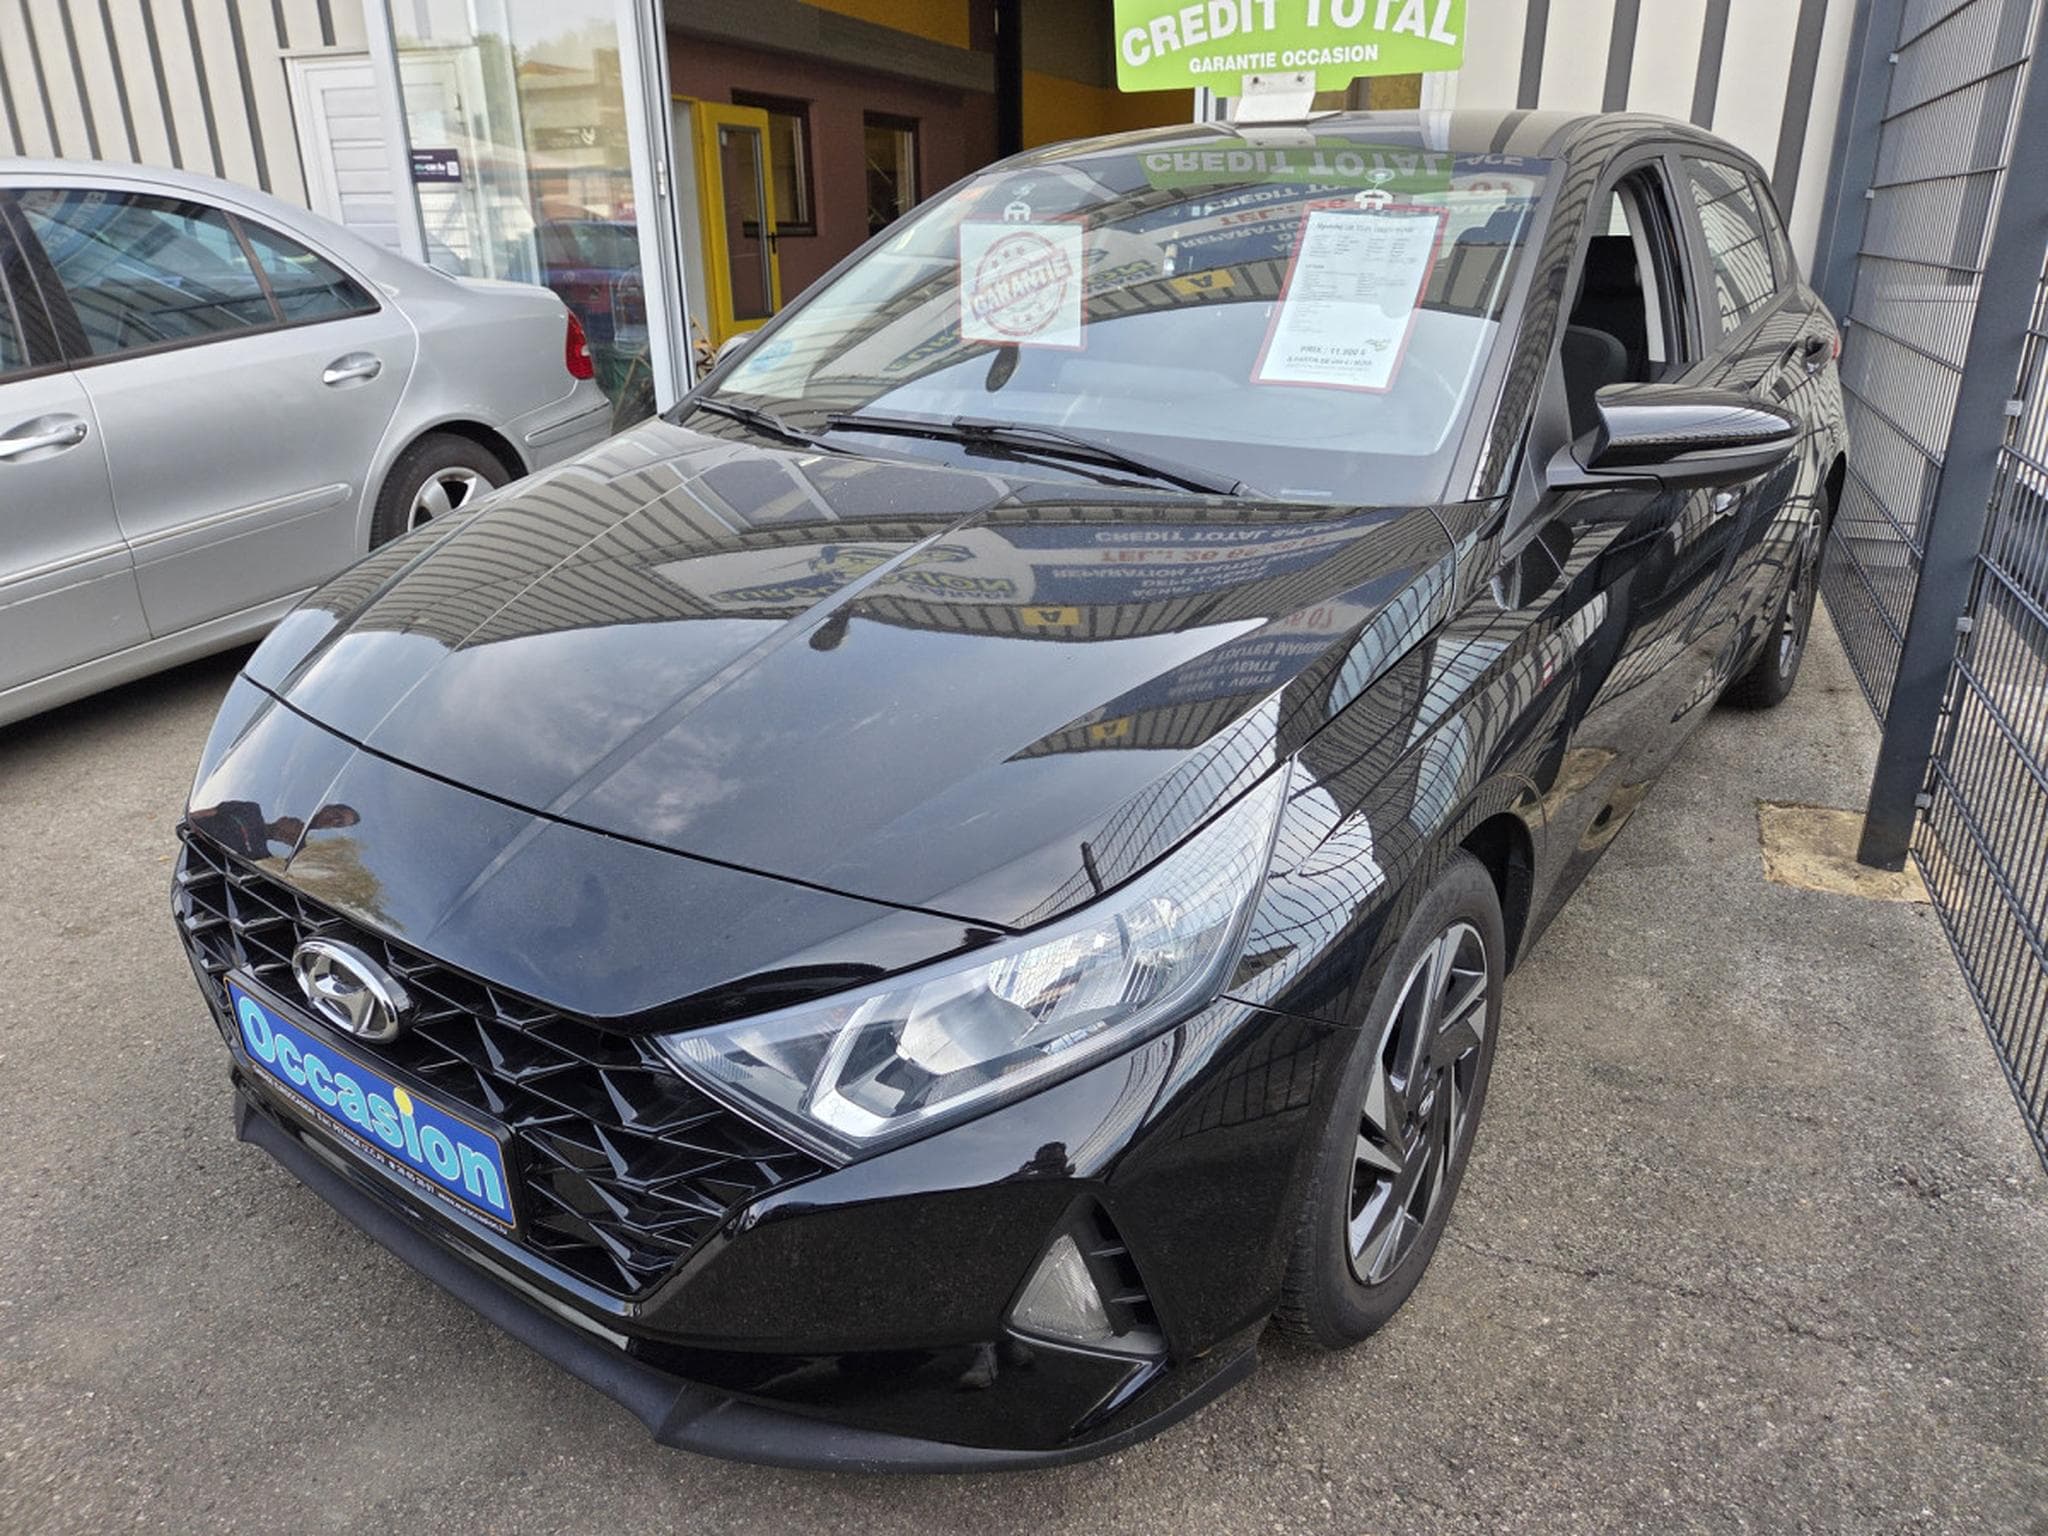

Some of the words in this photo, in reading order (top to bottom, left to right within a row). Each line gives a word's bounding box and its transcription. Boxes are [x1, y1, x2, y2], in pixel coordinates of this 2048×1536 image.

[1121, 0, 1277, 67] CREDIT
[1305, 0, 1457, 46] TOTAL
[1188, 52, 1277, 74] GARANTIE
[1281, 44, 1379, 67] OCCASION
[238, 996, 505, 1210] Occasion
